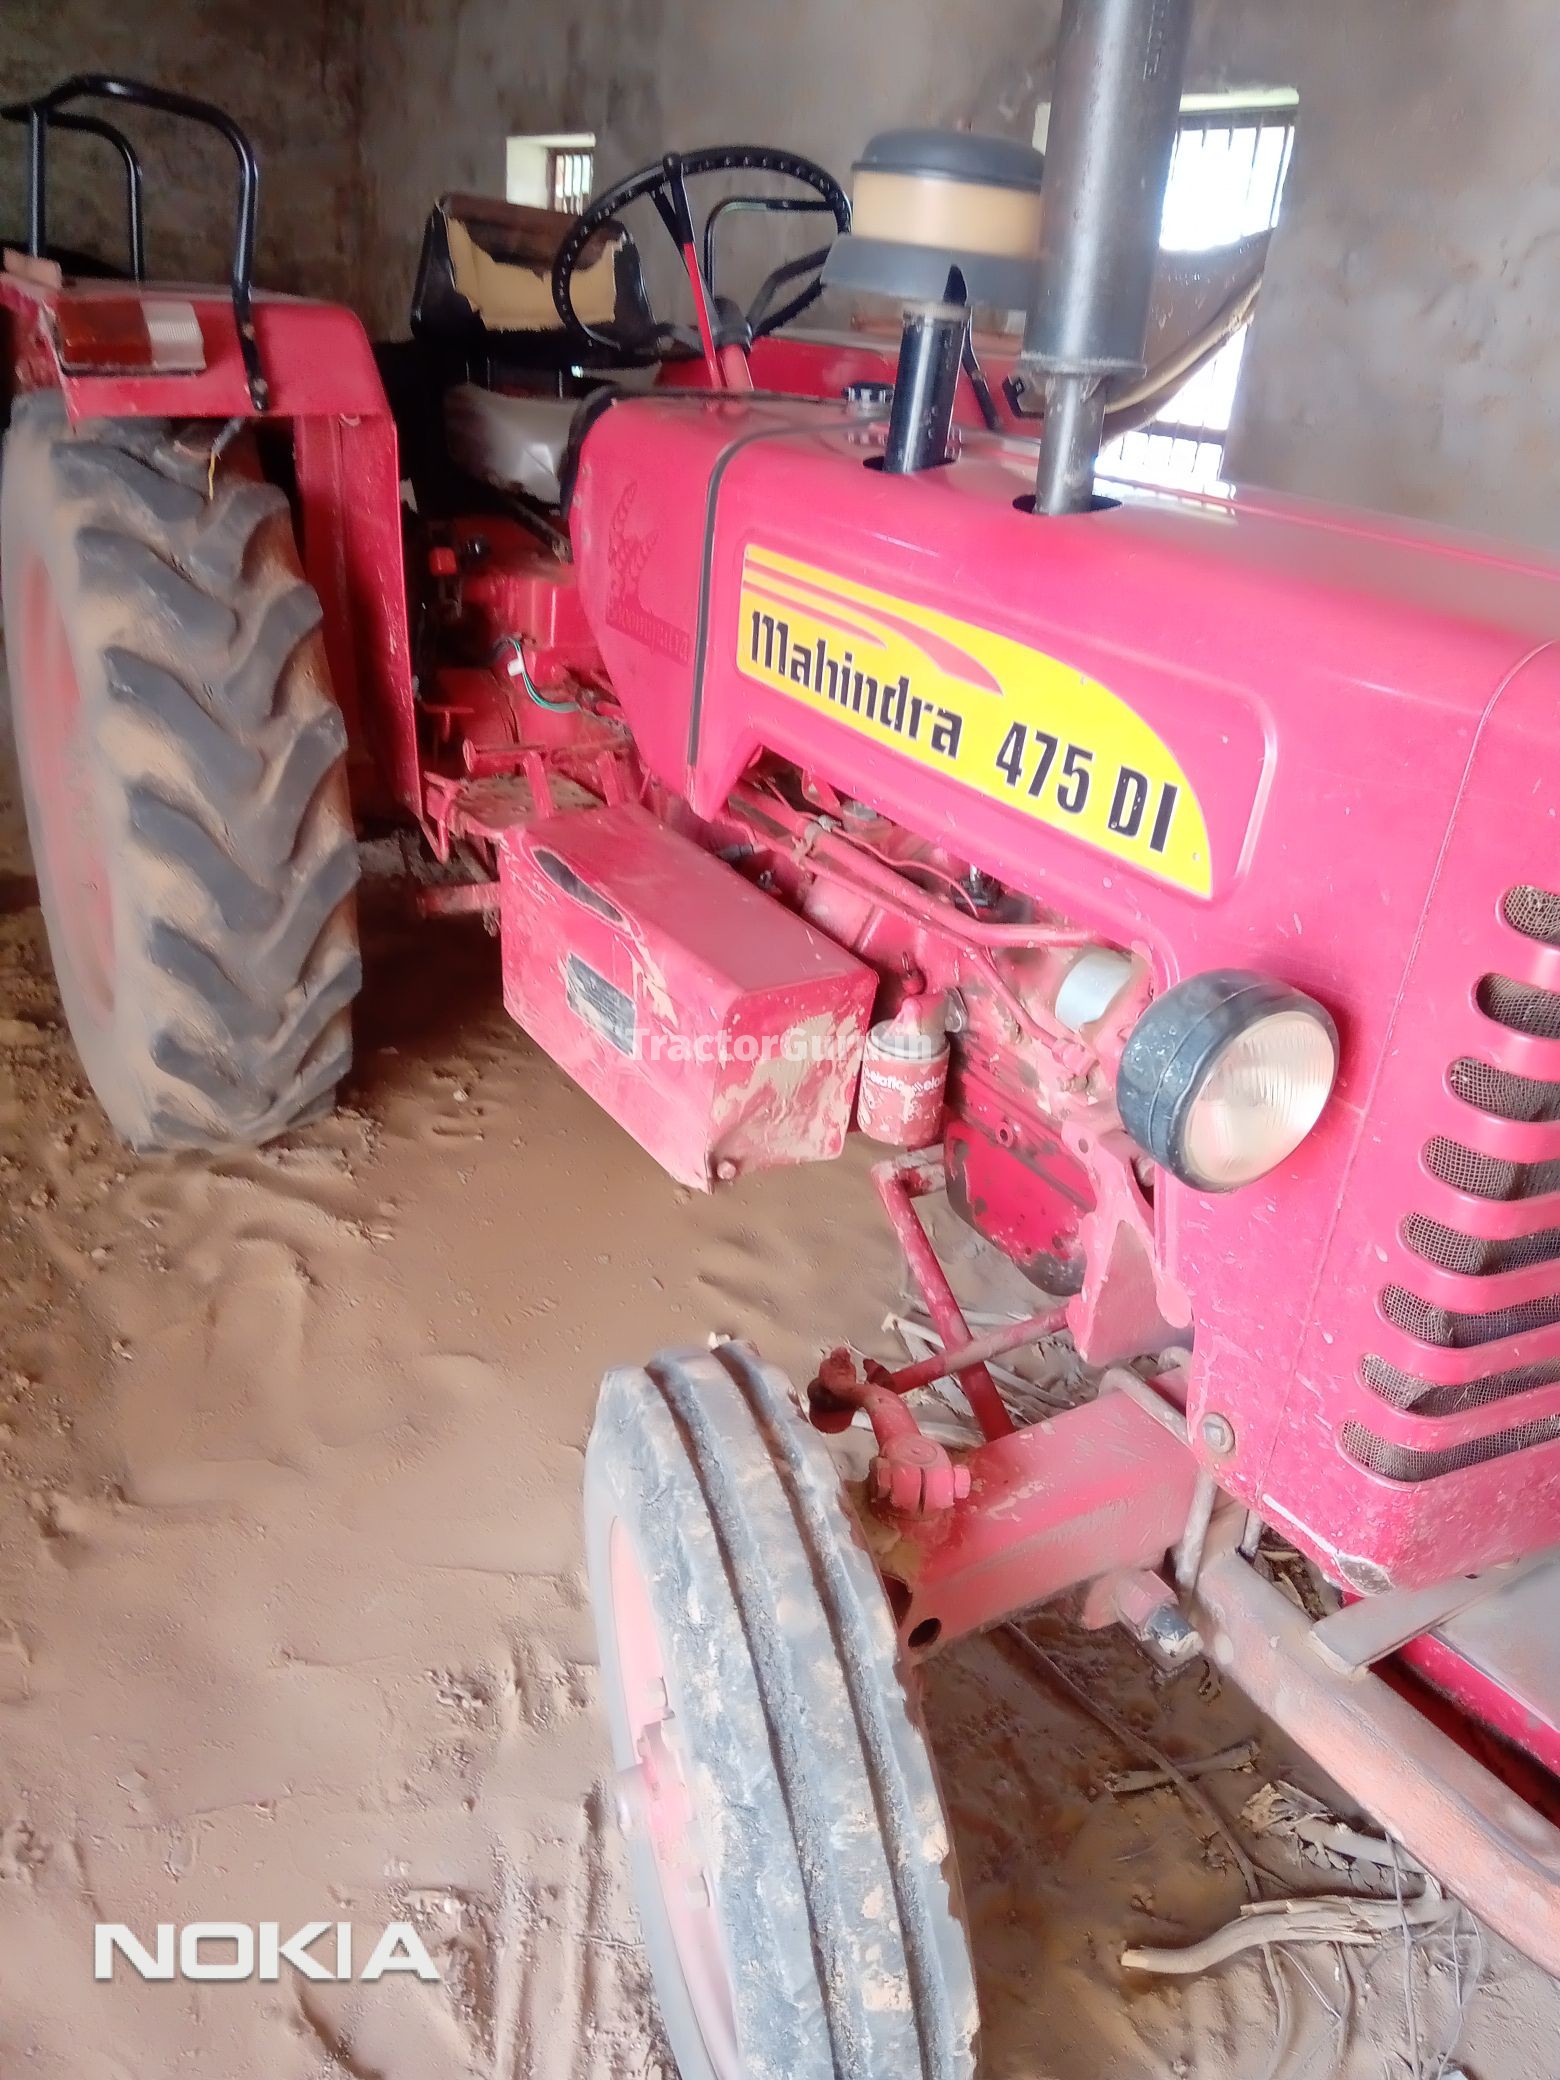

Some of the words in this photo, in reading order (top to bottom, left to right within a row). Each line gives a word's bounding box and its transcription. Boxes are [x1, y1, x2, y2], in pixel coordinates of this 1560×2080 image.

[751, 611, 963, 760] Mahindra
[995, 721, 1094, 815] 475
[1107, 765, 1178, 853] DI
